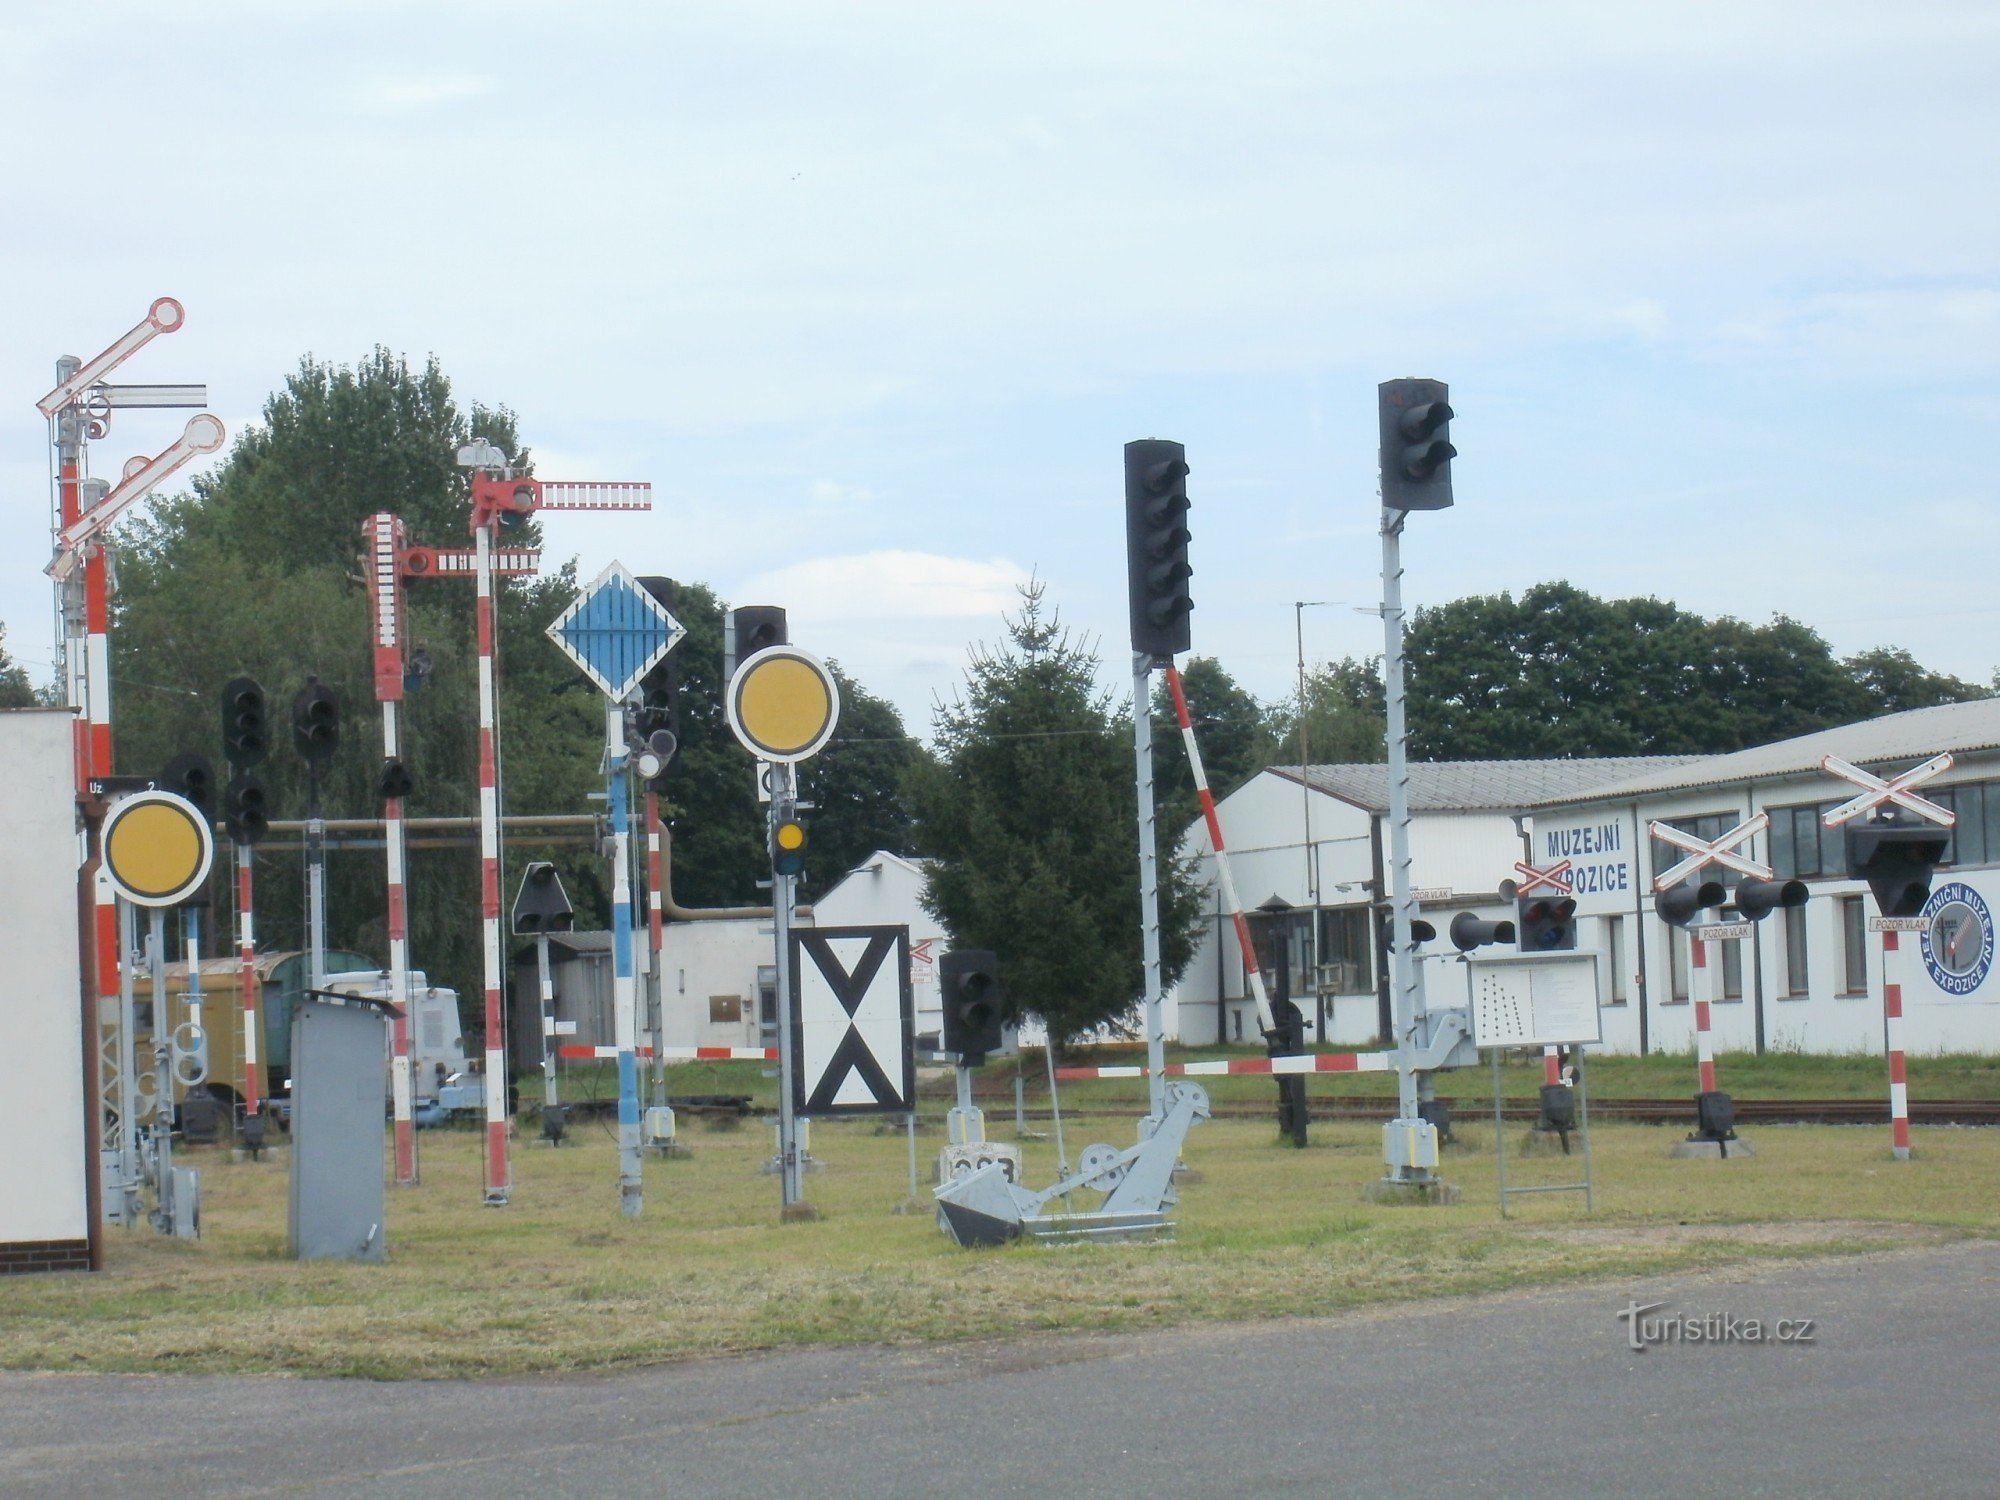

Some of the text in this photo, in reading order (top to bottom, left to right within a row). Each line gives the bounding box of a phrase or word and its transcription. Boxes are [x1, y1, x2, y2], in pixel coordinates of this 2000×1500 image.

[1547, 817, 1620, 857] MUZEJNÍ
[1555, 863, 1627, 895] POZICE
[1410, 890, 1448, 900] OZOR VLAK
[1703, 926, 1748, 938] POZOR VLAK
[1876, 919, 1926, 929] POZOR VLAK
[1921, 884, 1961, 967] ŽELZNIČNÍ
[1964, 889, 1992, 967] MUZEJNÍ
[1933, 965, 1984, 992] EXPOZICE
